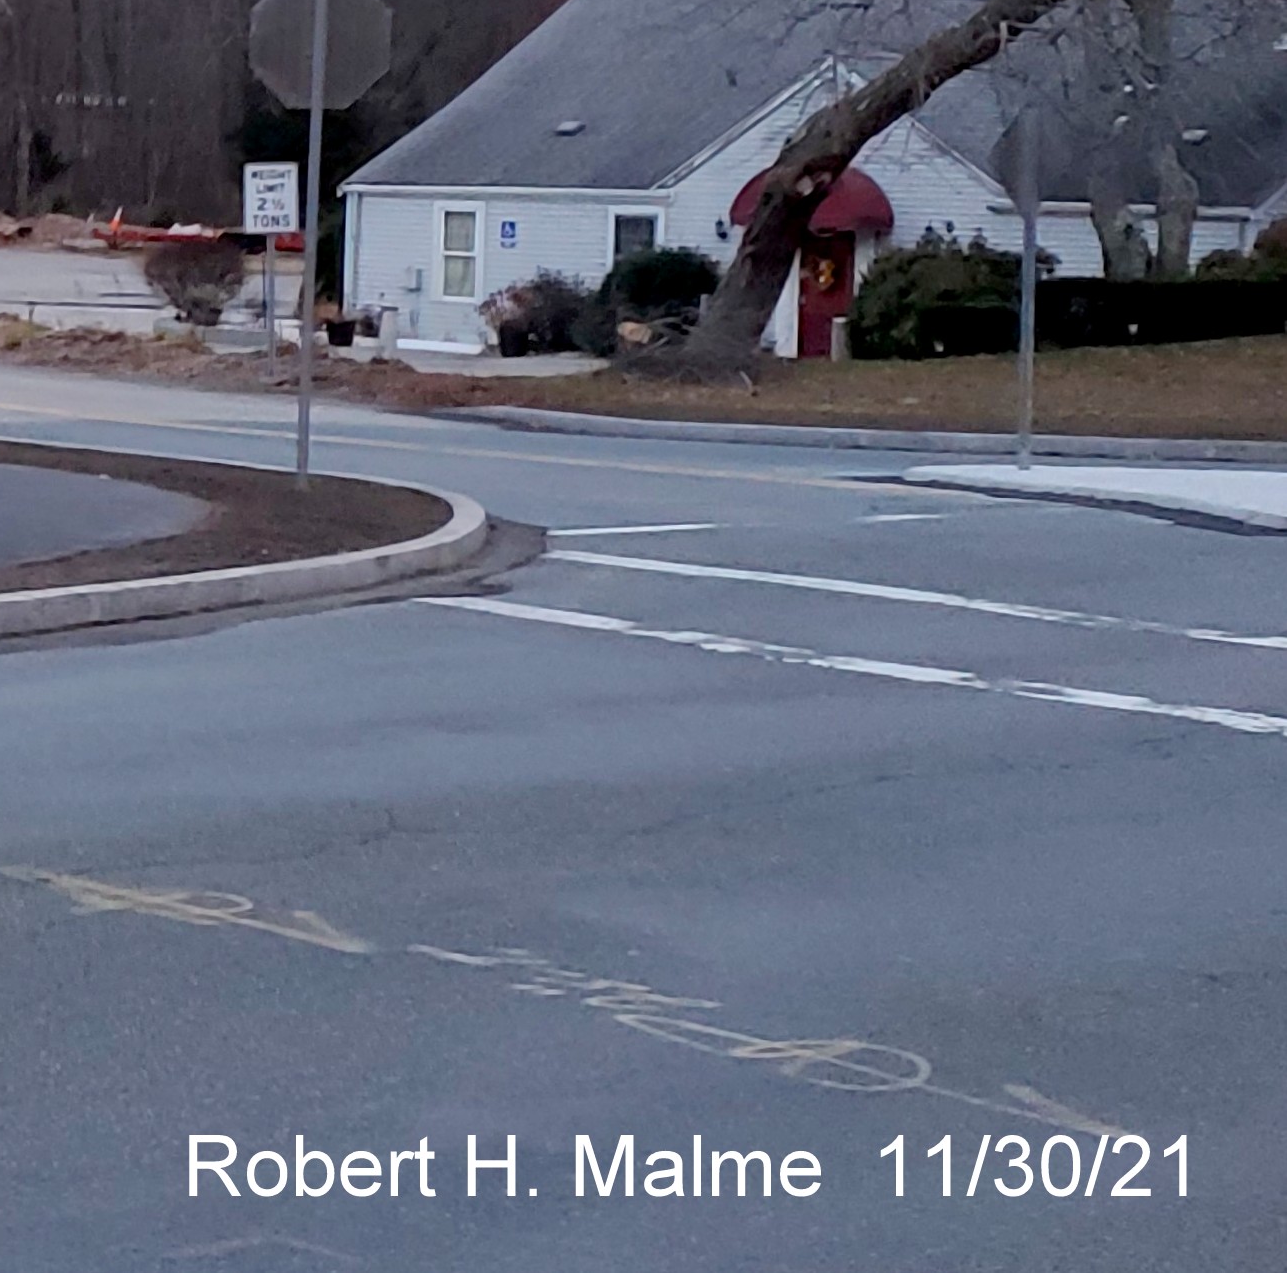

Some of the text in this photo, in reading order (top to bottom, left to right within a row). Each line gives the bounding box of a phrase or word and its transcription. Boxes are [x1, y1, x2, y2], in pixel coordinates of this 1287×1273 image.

[255, 182, 286, 195] LIMIT
[256, 197, 268, 212] 2
[252, 213, 291, 228] TONS
